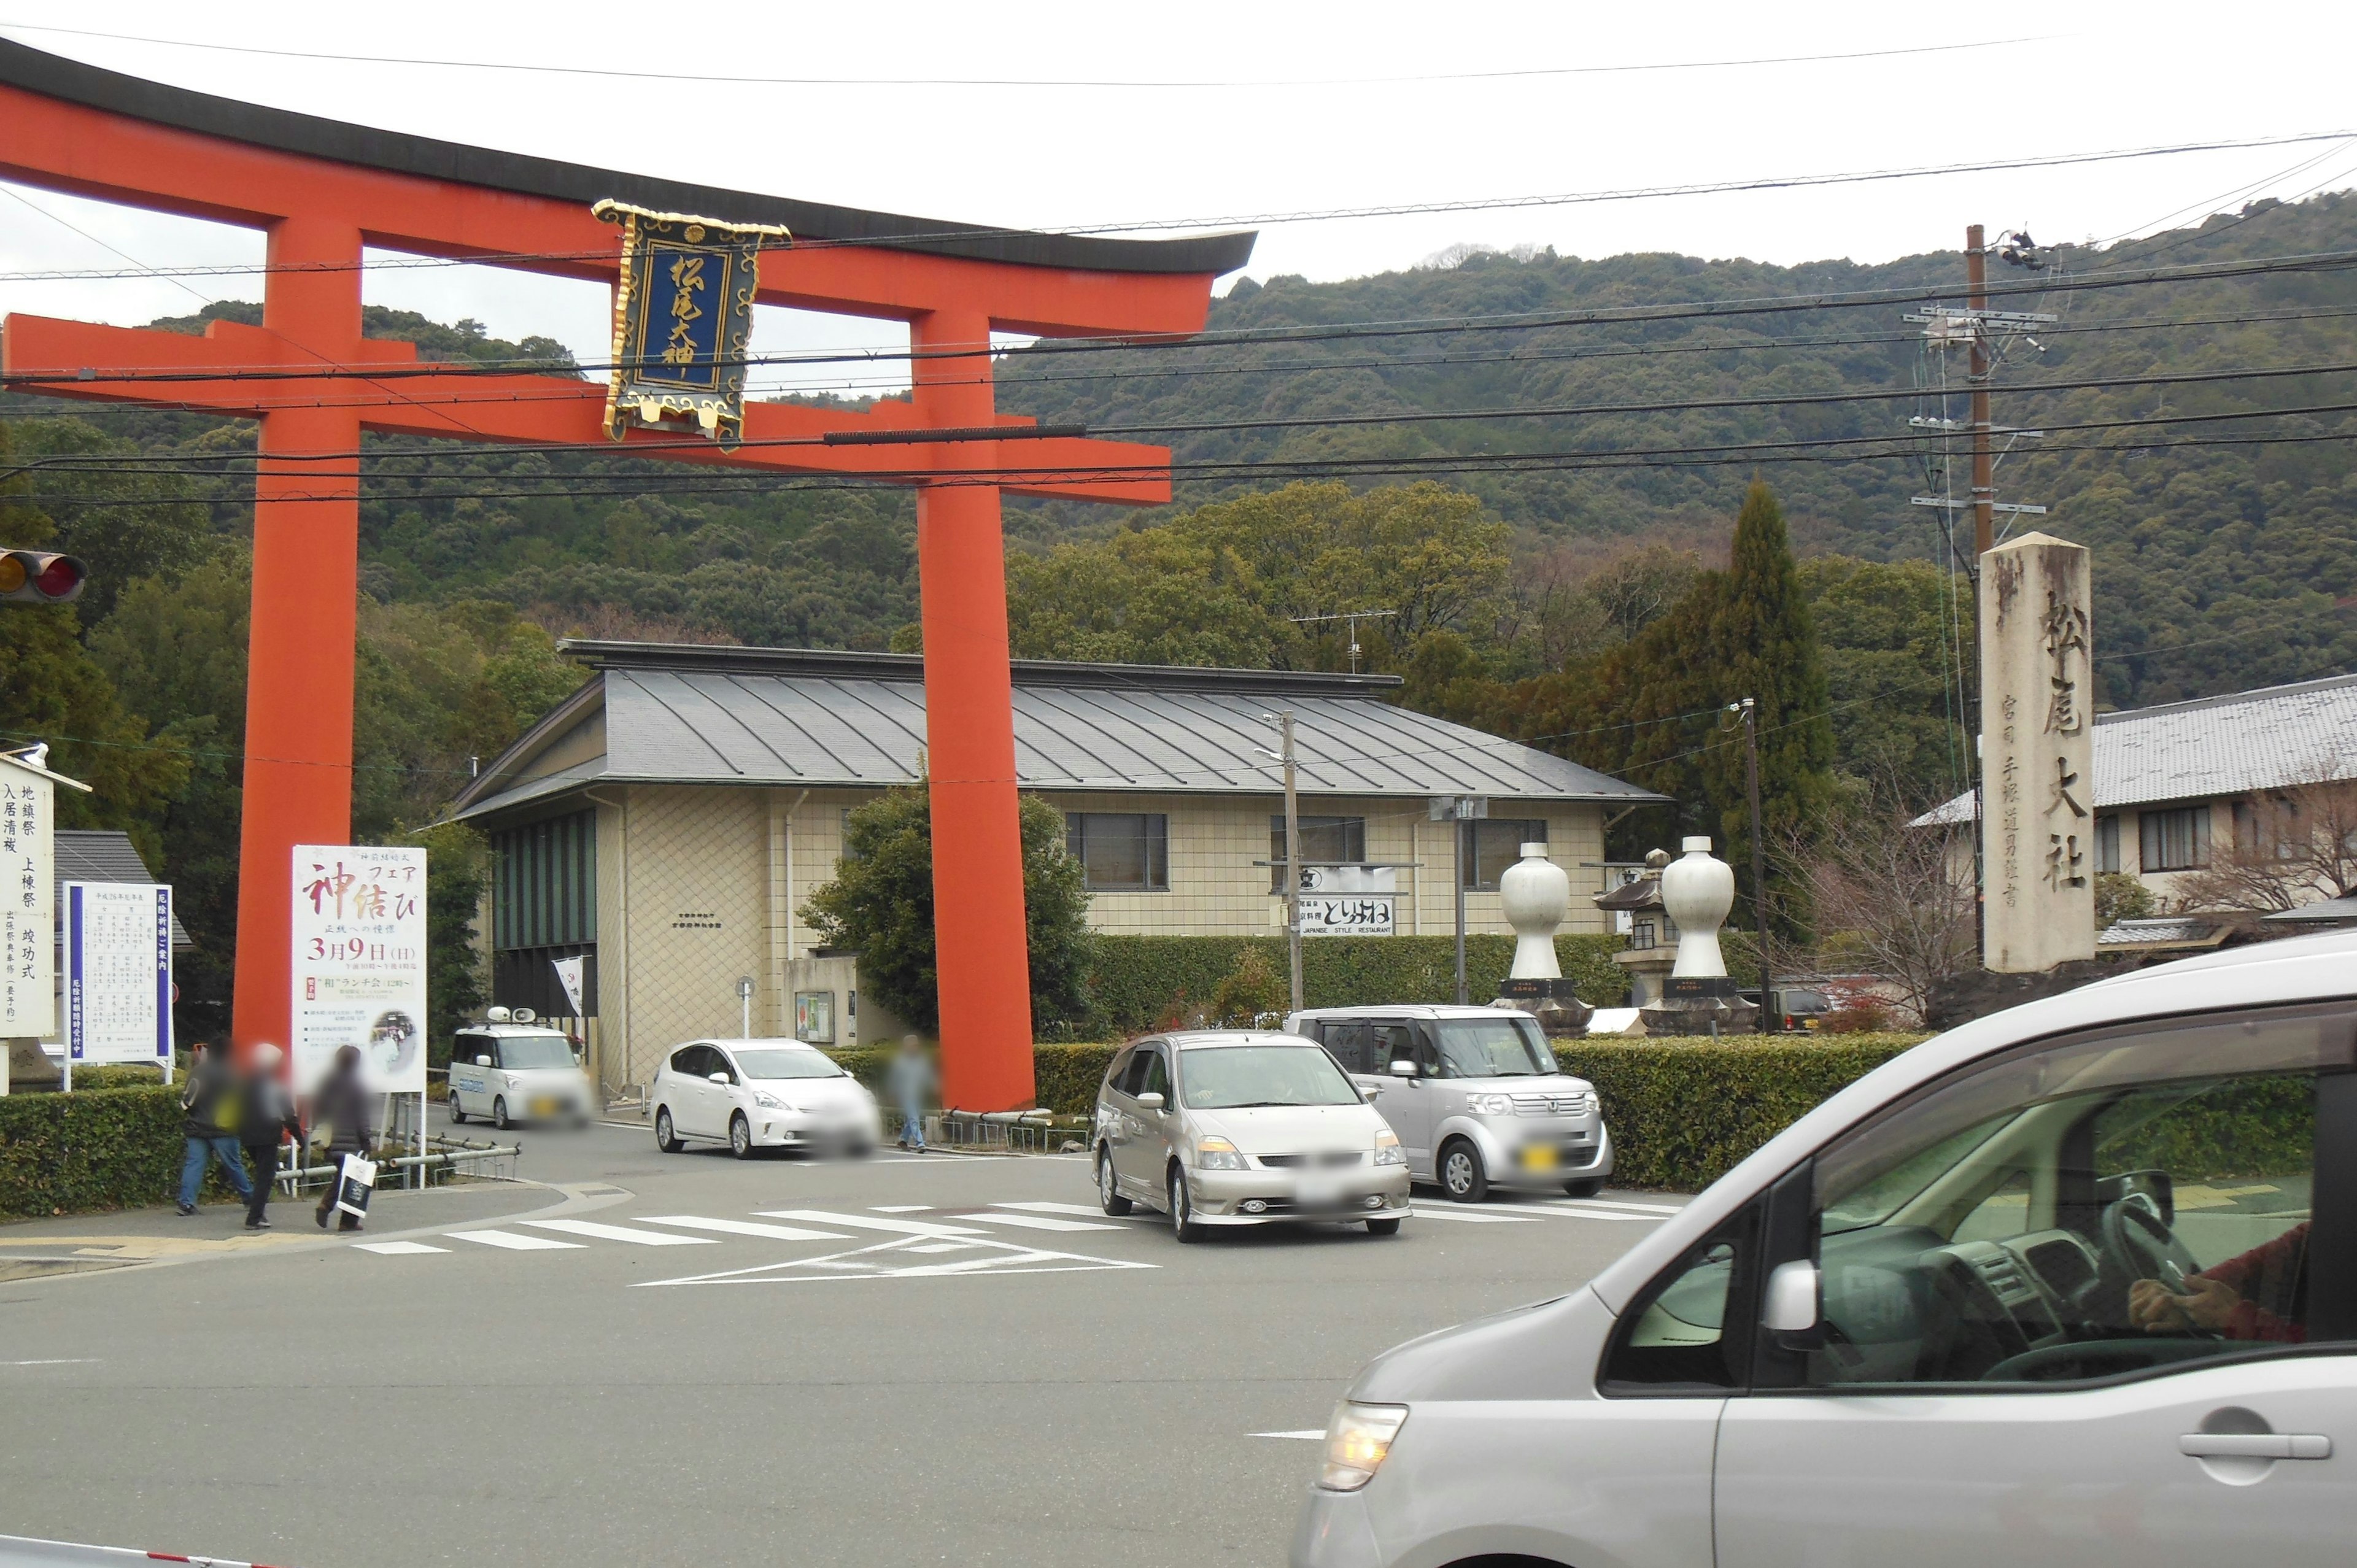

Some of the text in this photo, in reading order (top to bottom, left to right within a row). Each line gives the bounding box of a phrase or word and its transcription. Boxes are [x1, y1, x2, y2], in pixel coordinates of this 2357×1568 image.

[661, 255, 705, 379] 松尾大神
[2039, 591, 2088, 893] 松尾大社
[4, 784, 17, 853] 入居清祓
[21, 786, 36, 979] 地鎮祭 上棟祭 竣功式
[303, 862, 418, 920] 神結び
[369, 867, 417, 882] フェア
